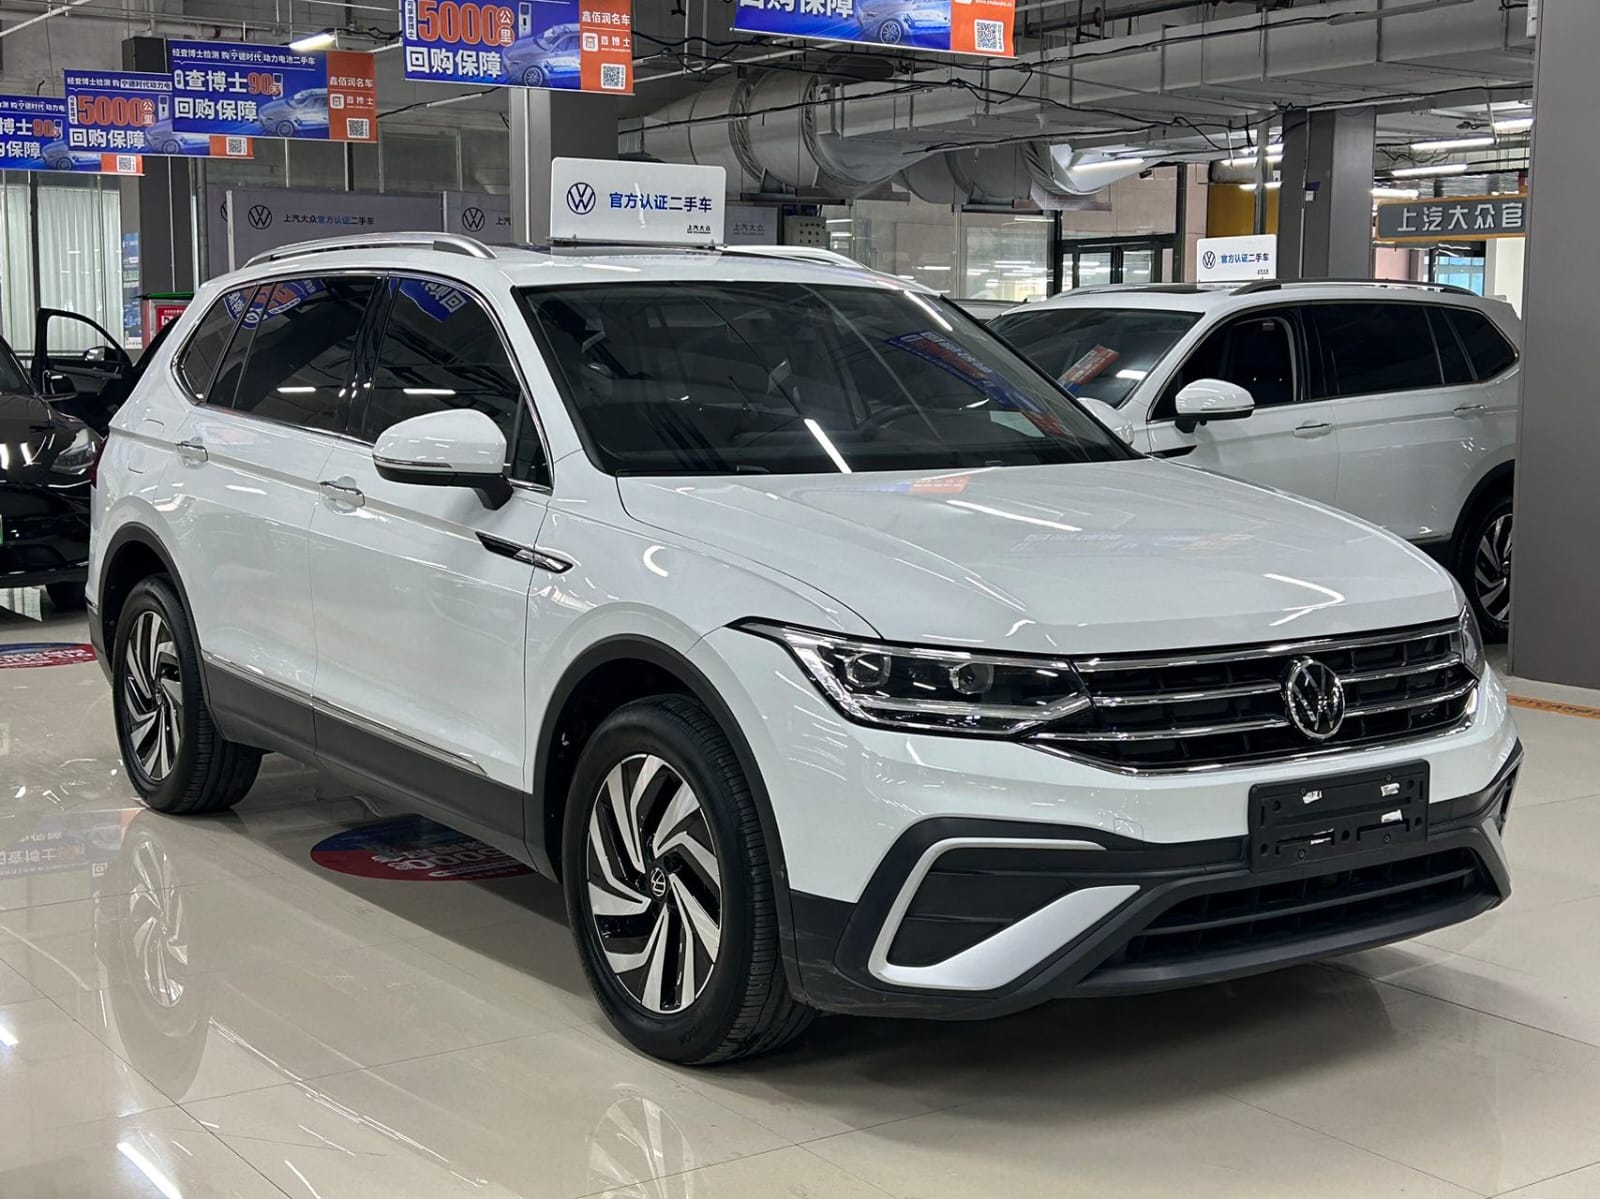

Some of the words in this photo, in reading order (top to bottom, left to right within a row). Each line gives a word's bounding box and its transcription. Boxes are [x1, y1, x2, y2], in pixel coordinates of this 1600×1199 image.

[405, 46, 503, 78] 回购保障
[174, 97, 259, 122] 回购保障
[69, 128, 146, 149] 回购保障
[609, 191, 713, 213] 官方认证二手车
[1397, 202, 1523, 232] 上汽大众官
[1221, 253, 1270, 265] 官方认证二手车
